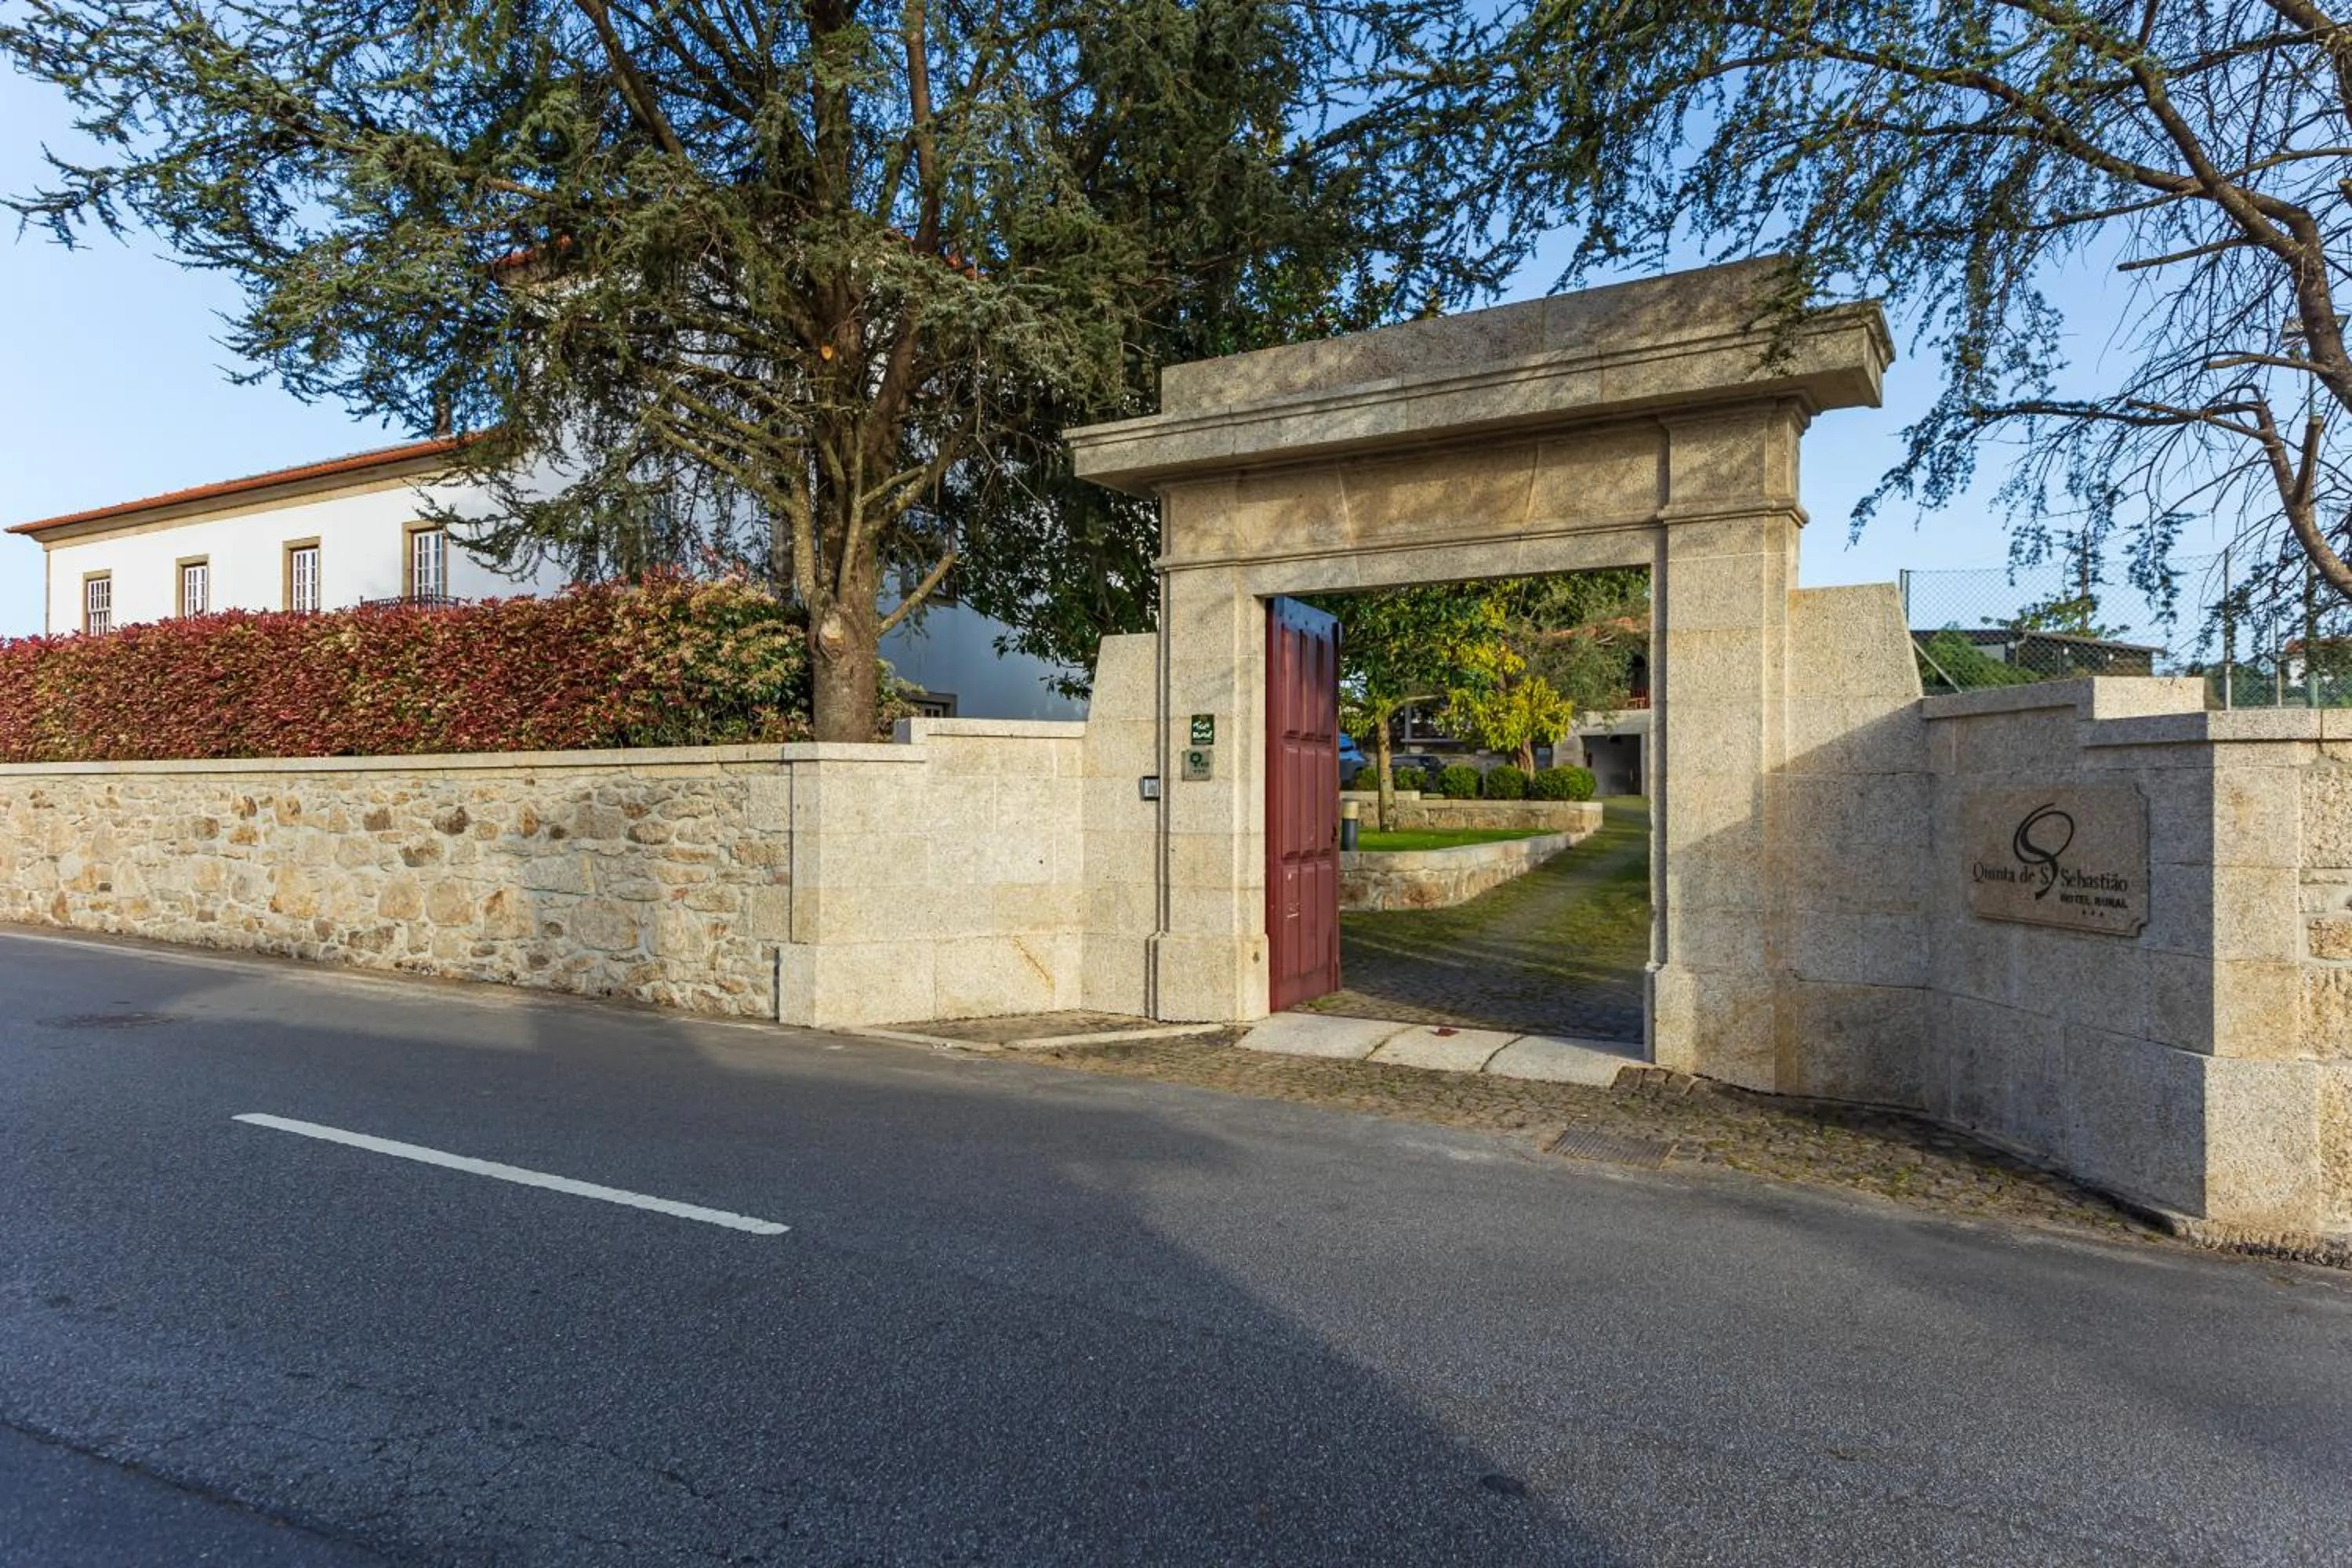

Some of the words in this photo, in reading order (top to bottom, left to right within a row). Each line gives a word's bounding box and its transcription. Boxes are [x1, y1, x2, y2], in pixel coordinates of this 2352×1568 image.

[1973, 862, 2015, 884] Quinta
[2020, 866, 2035, 883] de
[2060, 868, 2128, 892] Sebastião
